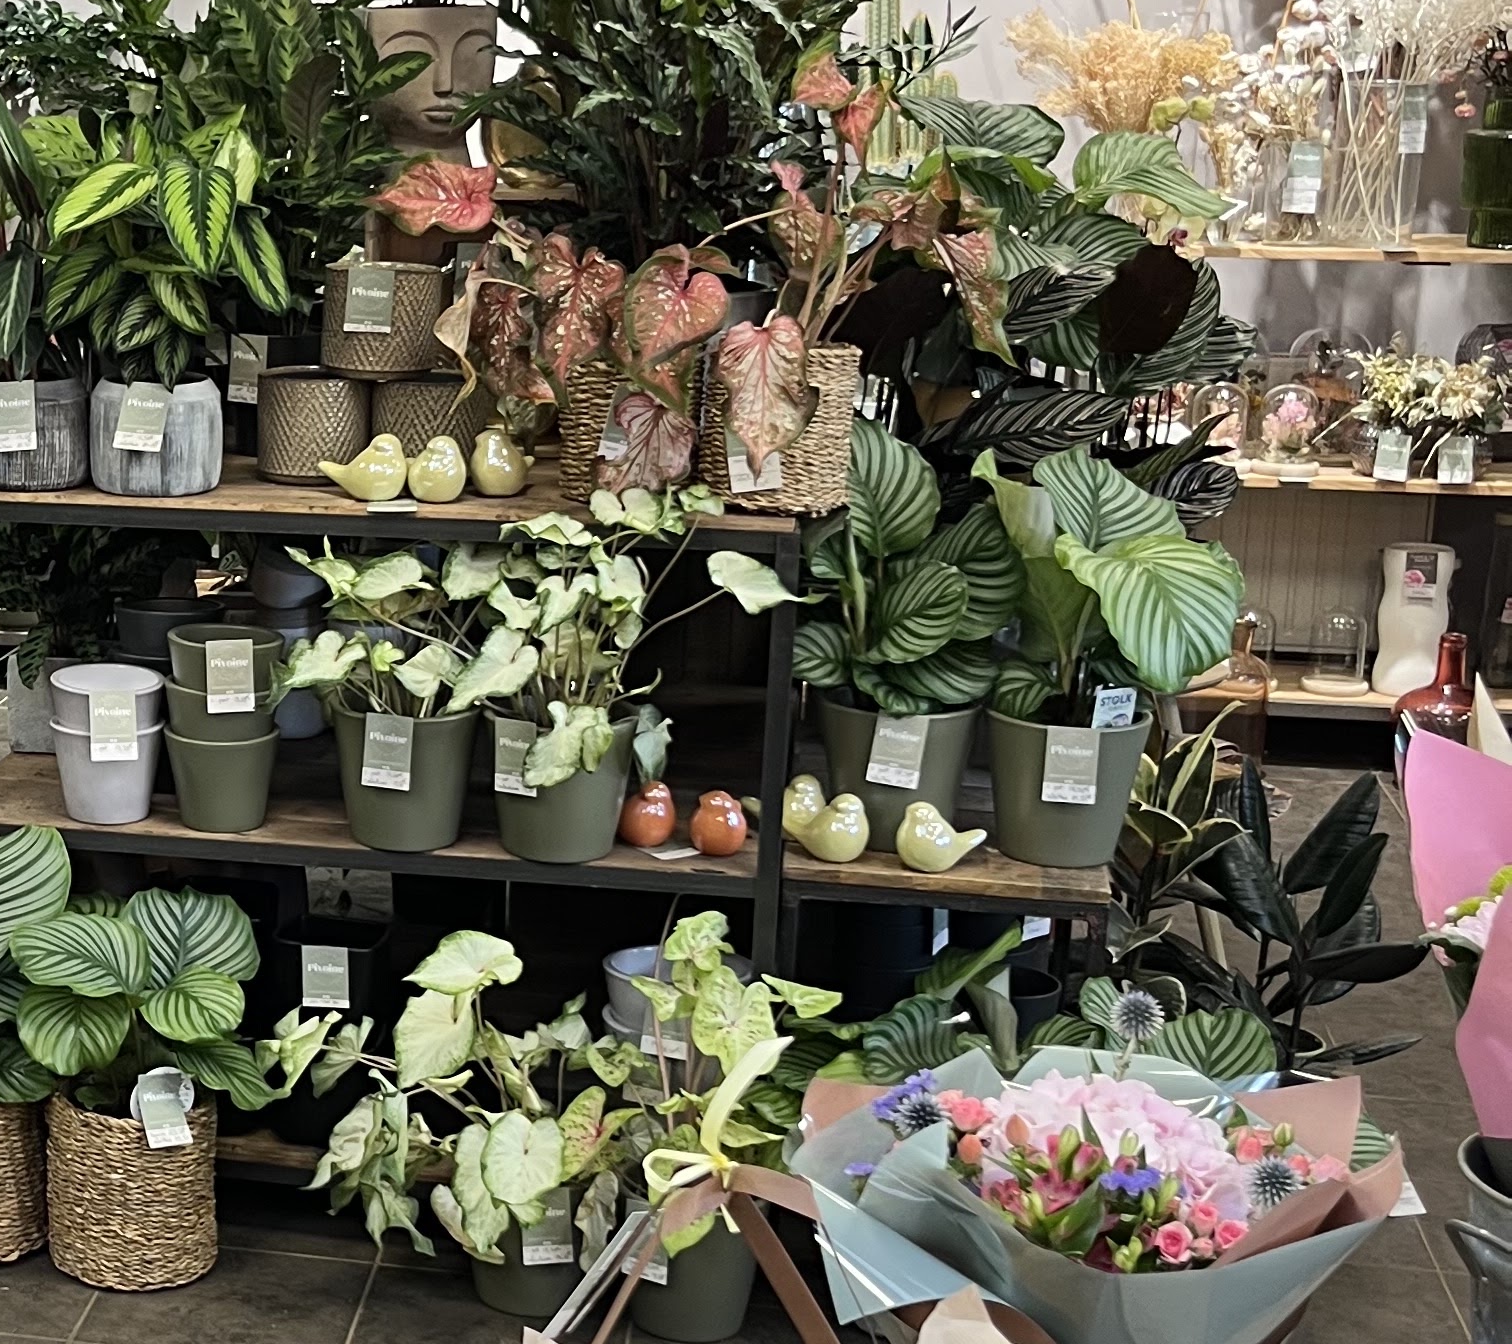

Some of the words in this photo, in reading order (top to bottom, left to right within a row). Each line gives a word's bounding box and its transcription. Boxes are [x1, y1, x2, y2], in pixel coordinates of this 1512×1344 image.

[351, 286, 390, 299] Pivoine
[127, 398, 166, 409] Pivoine
[210, 657, 249, 668] Pivoine
[94, 706, 133, 717] Pivoine
[369, 731, 408, 745] Pivoine
[1050, 744, 1094, 757] Pivoine
[307, 962, 346, 974] Pivoine
